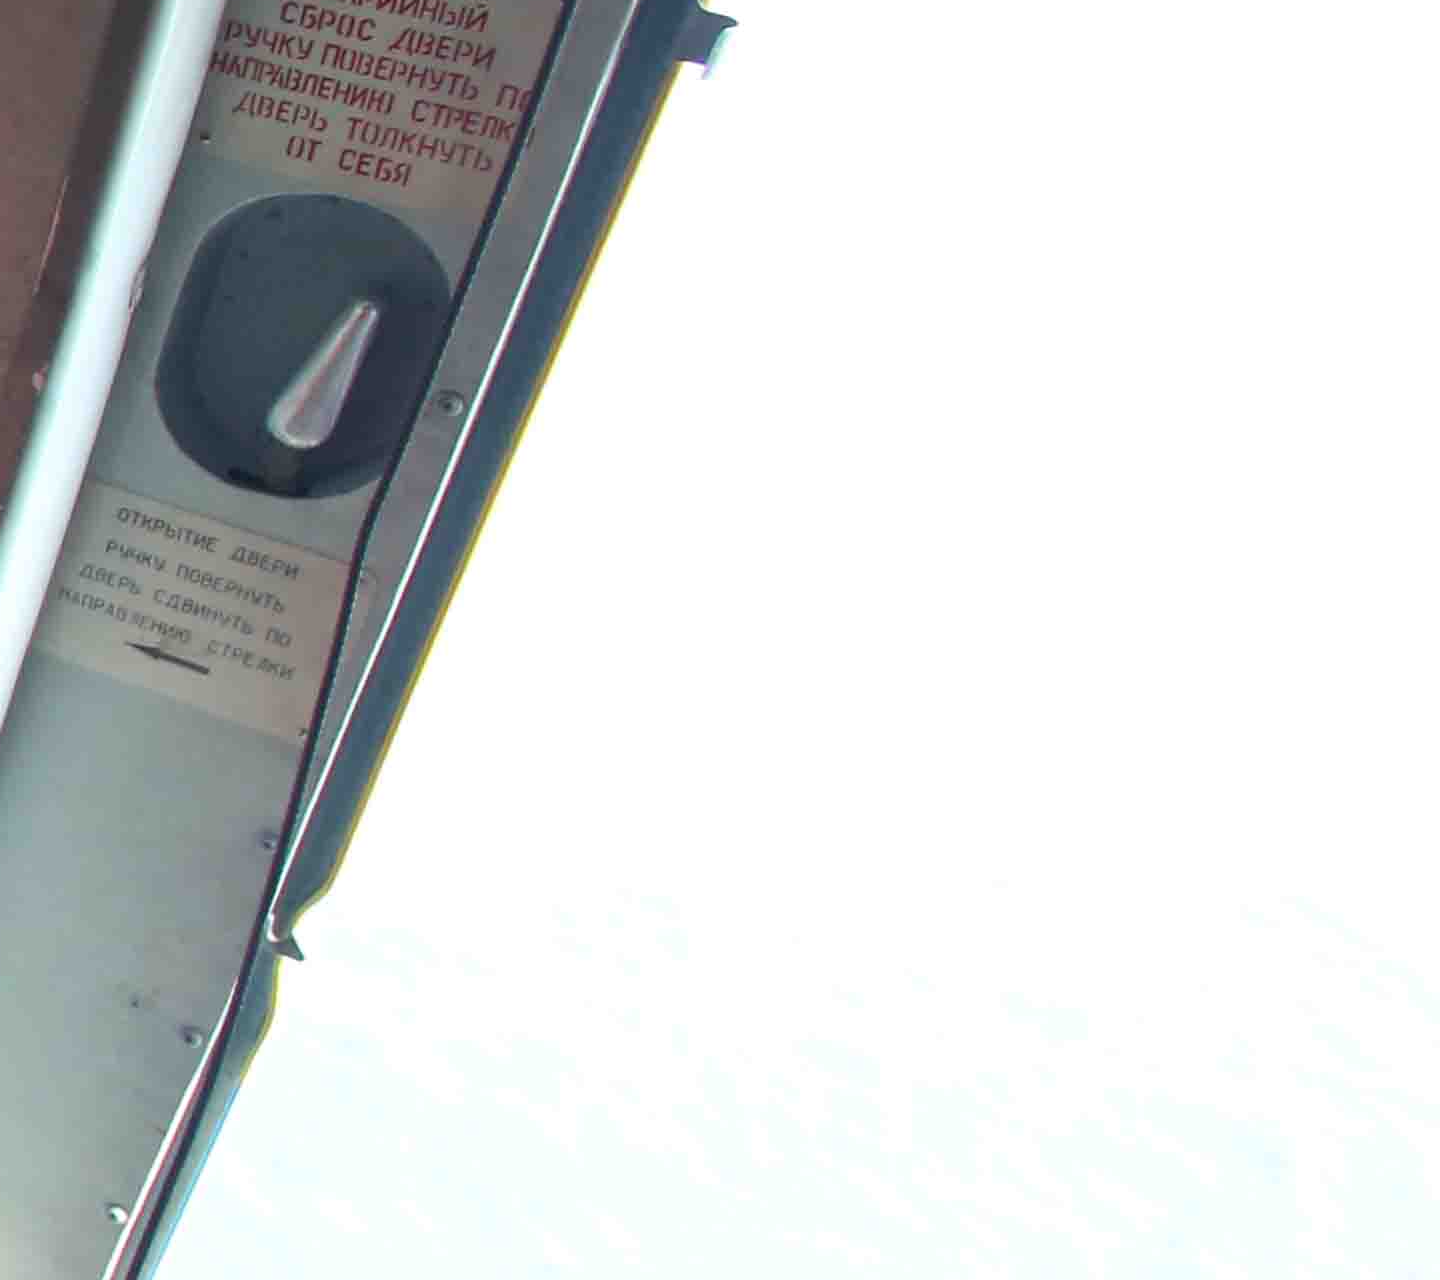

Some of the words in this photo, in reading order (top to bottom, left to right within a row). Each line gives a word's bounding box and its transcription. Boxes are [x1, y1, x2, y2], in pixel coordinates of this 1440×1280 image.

[223, 20, 314, 61] РУЧКУ
[320, 42, 479, 101] ПОВЕРНУТЬ
[280, 0, 377, 42] СБРОС
[387, 27, 496, 72] ДВЕРИ
[209, 49, 396, 115] НАПРАВЛЕНИЮ
[232, 90, 329, 132] ДВЕРЬ
[347, 117, 494, 172] ТОЛКНУТЬ
[285, 135, 323, 162] ОТ
[338, 148, 413, 188] СЕБЯ
[116, 506, 221, 553] ОТКРЫТИЕ
[229, 544, 300, 581] ДВЕРИ
[79, 563, 142, 596] ДВЕРЬ
[265, 626, 292, 649] ПО
